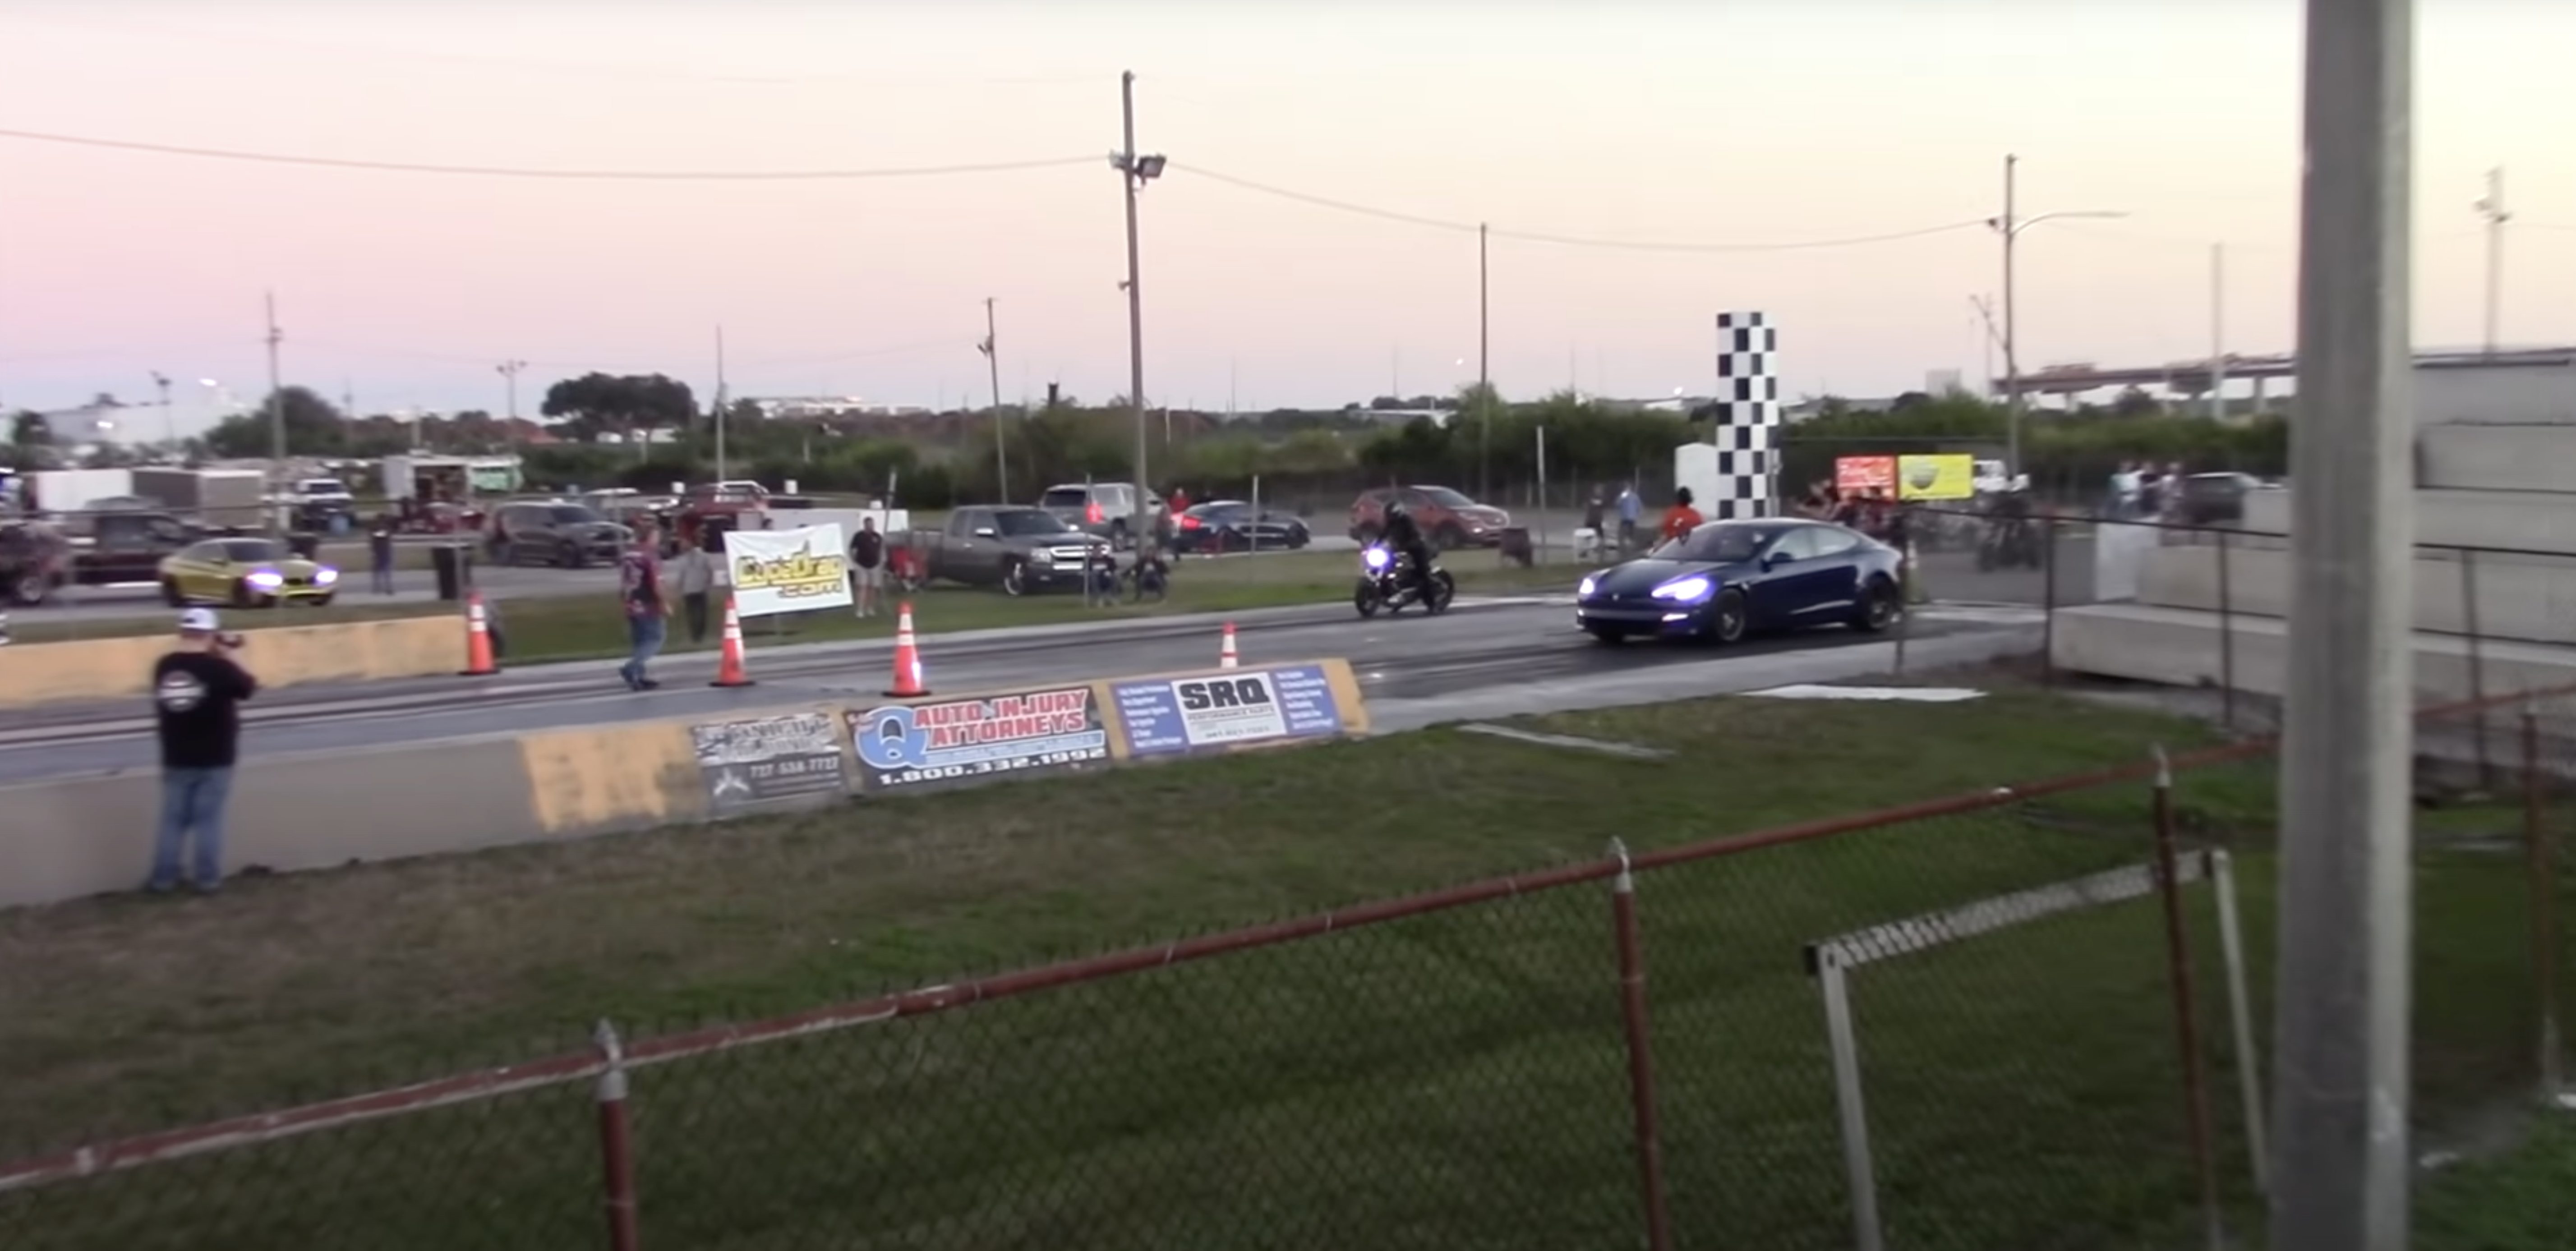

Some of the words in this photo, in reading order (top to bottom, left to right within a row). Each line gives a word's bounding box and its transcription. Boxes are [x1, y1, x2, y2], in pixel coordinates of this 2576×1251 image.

[913, 701, 982, 728] AUTO
[994, 690, 1088, 718] INJURY
[1179, 677, 1270, 710] SRQ
[930, 711, 1086, 748] ATTORNEYS
[880, 747, 1106, 785] 1.800.332.1992
